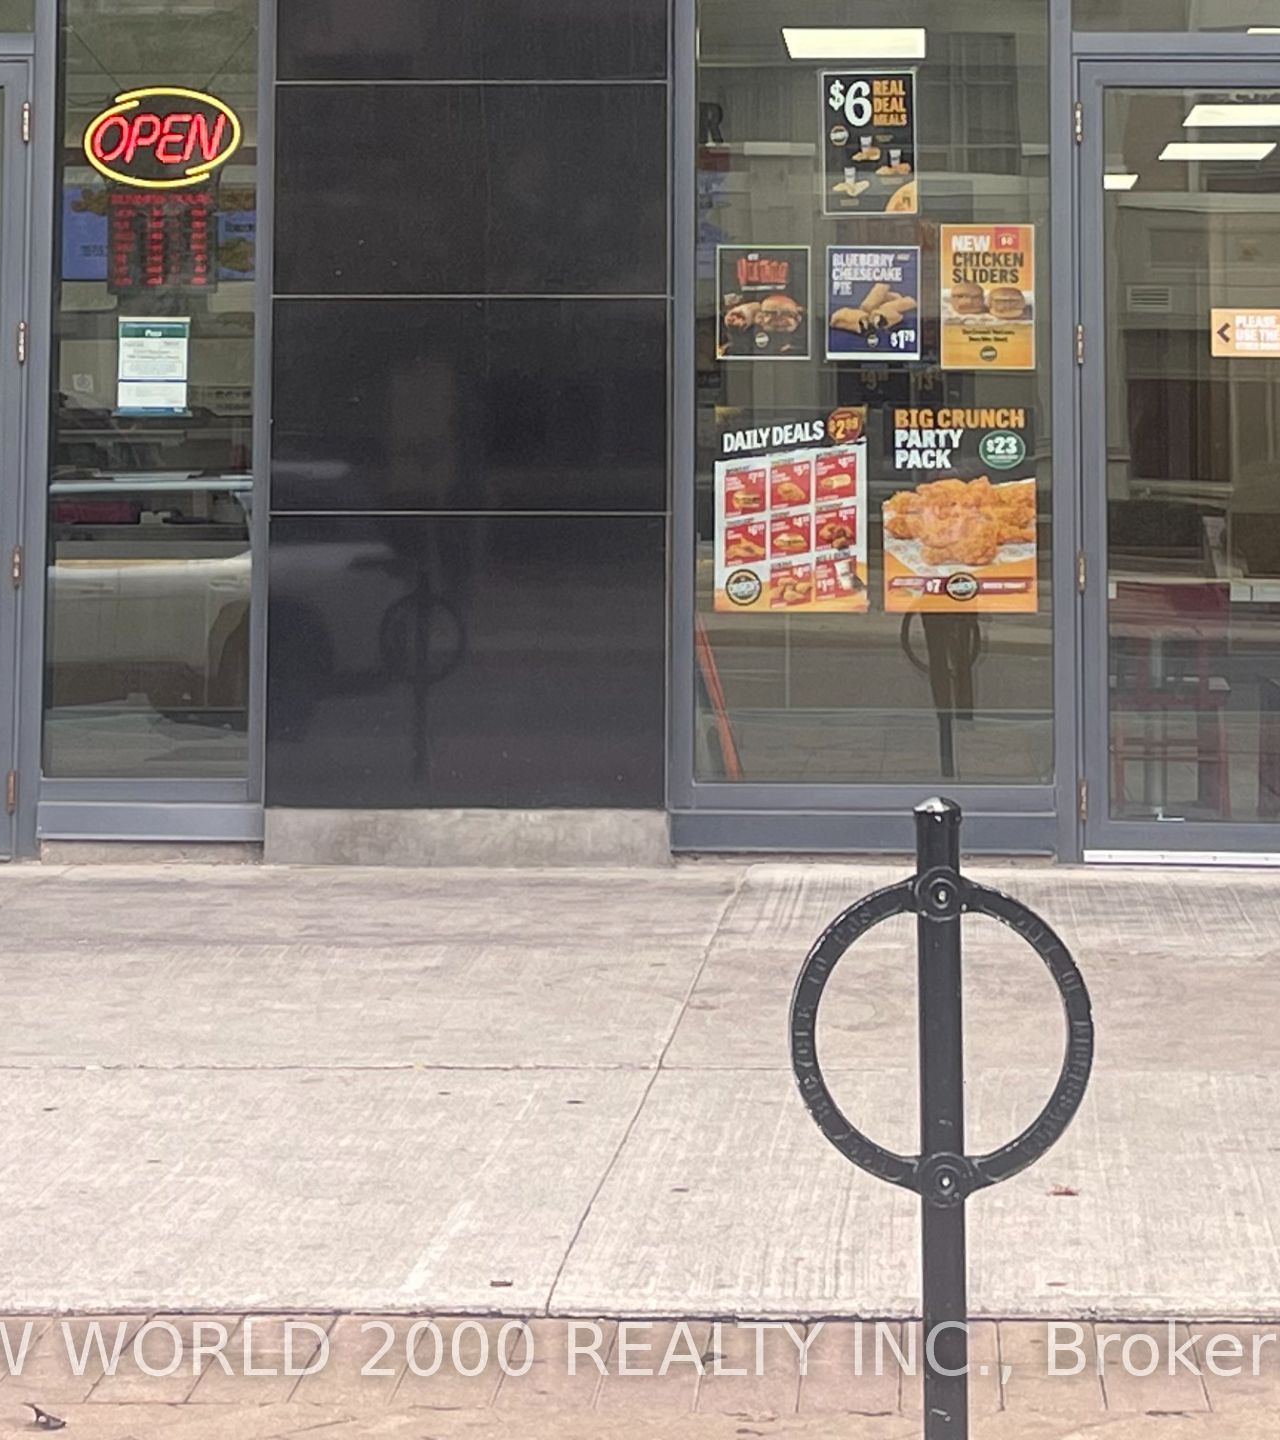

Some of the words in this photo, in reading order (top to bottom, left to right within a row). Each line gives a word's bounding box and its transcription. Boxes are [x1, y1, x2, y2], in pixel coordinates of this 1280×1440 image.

[872, 79, 906, 96] REAL
[828, 79, 873, 127] $6
[872, 97, 907, 113] DEAL
[873, 113, 908, 126] MEALS
[93, 112, 226, 164] OPEN
[951, 234, 991, 252] NEW
[832, 252, 896, 268] BLUEBERRY
[951, 251, 1024, 268] CHICKEN
[832, 267, 902, 282] CHEESECAKE
[951, 268, 1020, 284] SLIDERS
[832, 281, 853, 296] PIE
[894, 408, 934, 428] BIG
[936, 408, 1025, 429] CRUNCH
[722, 426, 771, 453] DAILY
[771, 420, 825, 446] DEALS
[894, 428, 964, 449] PARTY
[986, 436, 1018, 455] $23
[894, 448, 952, 469] PACK
